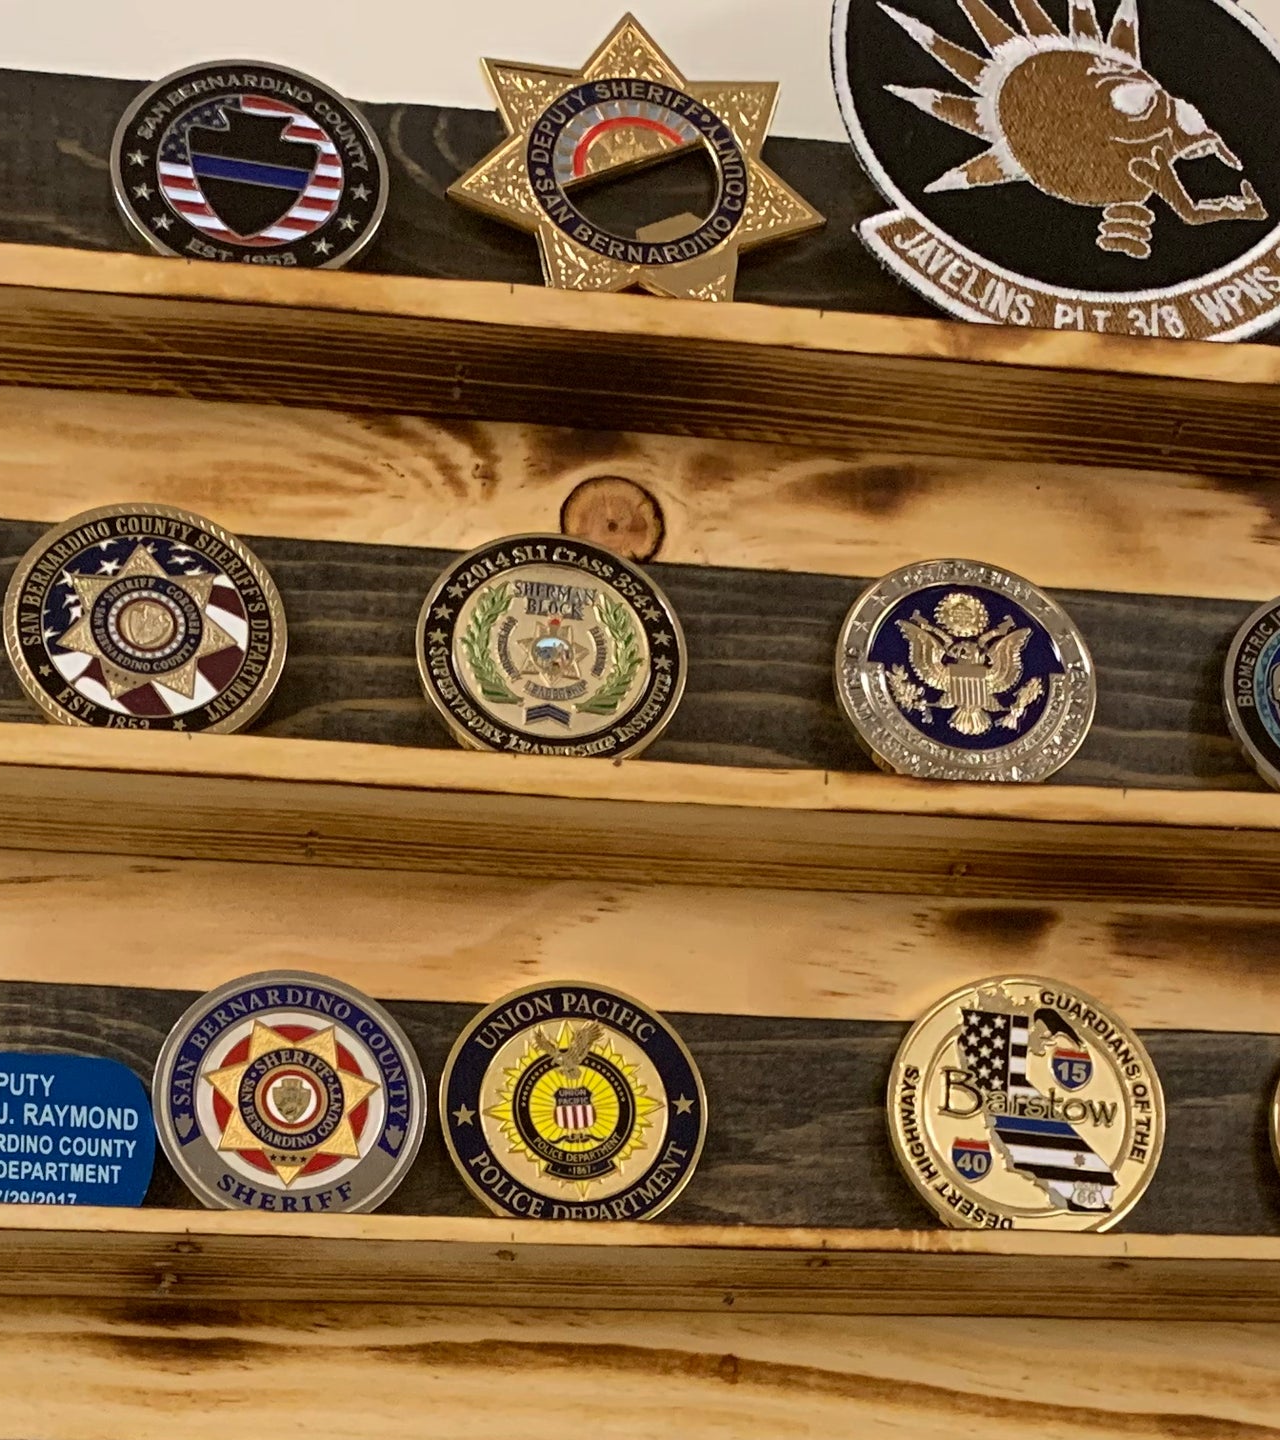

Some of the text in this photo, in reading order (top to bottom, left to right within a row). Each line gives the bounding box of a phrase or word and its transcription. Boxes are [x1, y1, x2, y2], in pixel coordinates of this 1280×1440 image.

[137, 74, 368, 171] SAN BERNARDINO COUNTY
[531, 81, 701, 164] DEPUTY SHERIFF
[534, 122, 744, 263] SAN BERNARDINO COUNTY
[23, 517, 269, 722] SAN BERNARDINO COUNTY SHERIFF'S DEPARTMENT
[1238, 622, 1274, 707] BIOMETRIC
[174, 988, 407, 1119] SAN BERNARDINO COUNTY
[474, 991, 656, 1050] UNION PACIFIC
[254, 1050, 334, 1078] SHERIFF
[938, 1067, 1118, 1127] Barstow
[1058, 1062, 1086, 1083] 15
[23, 1103, 139, 1131] RAYMOND
[900, 990, 1152, 1229] GUARDIANS OF THE DESERT HIGHWAYS
[58, 1136, 137, 1159] COUNTY
[469, 1140, 687, 1220] POLICE DEPARTMENT
[957, 1155, 987, 1174] 40
[217, 1173, 353, 1212] SHERIFF
